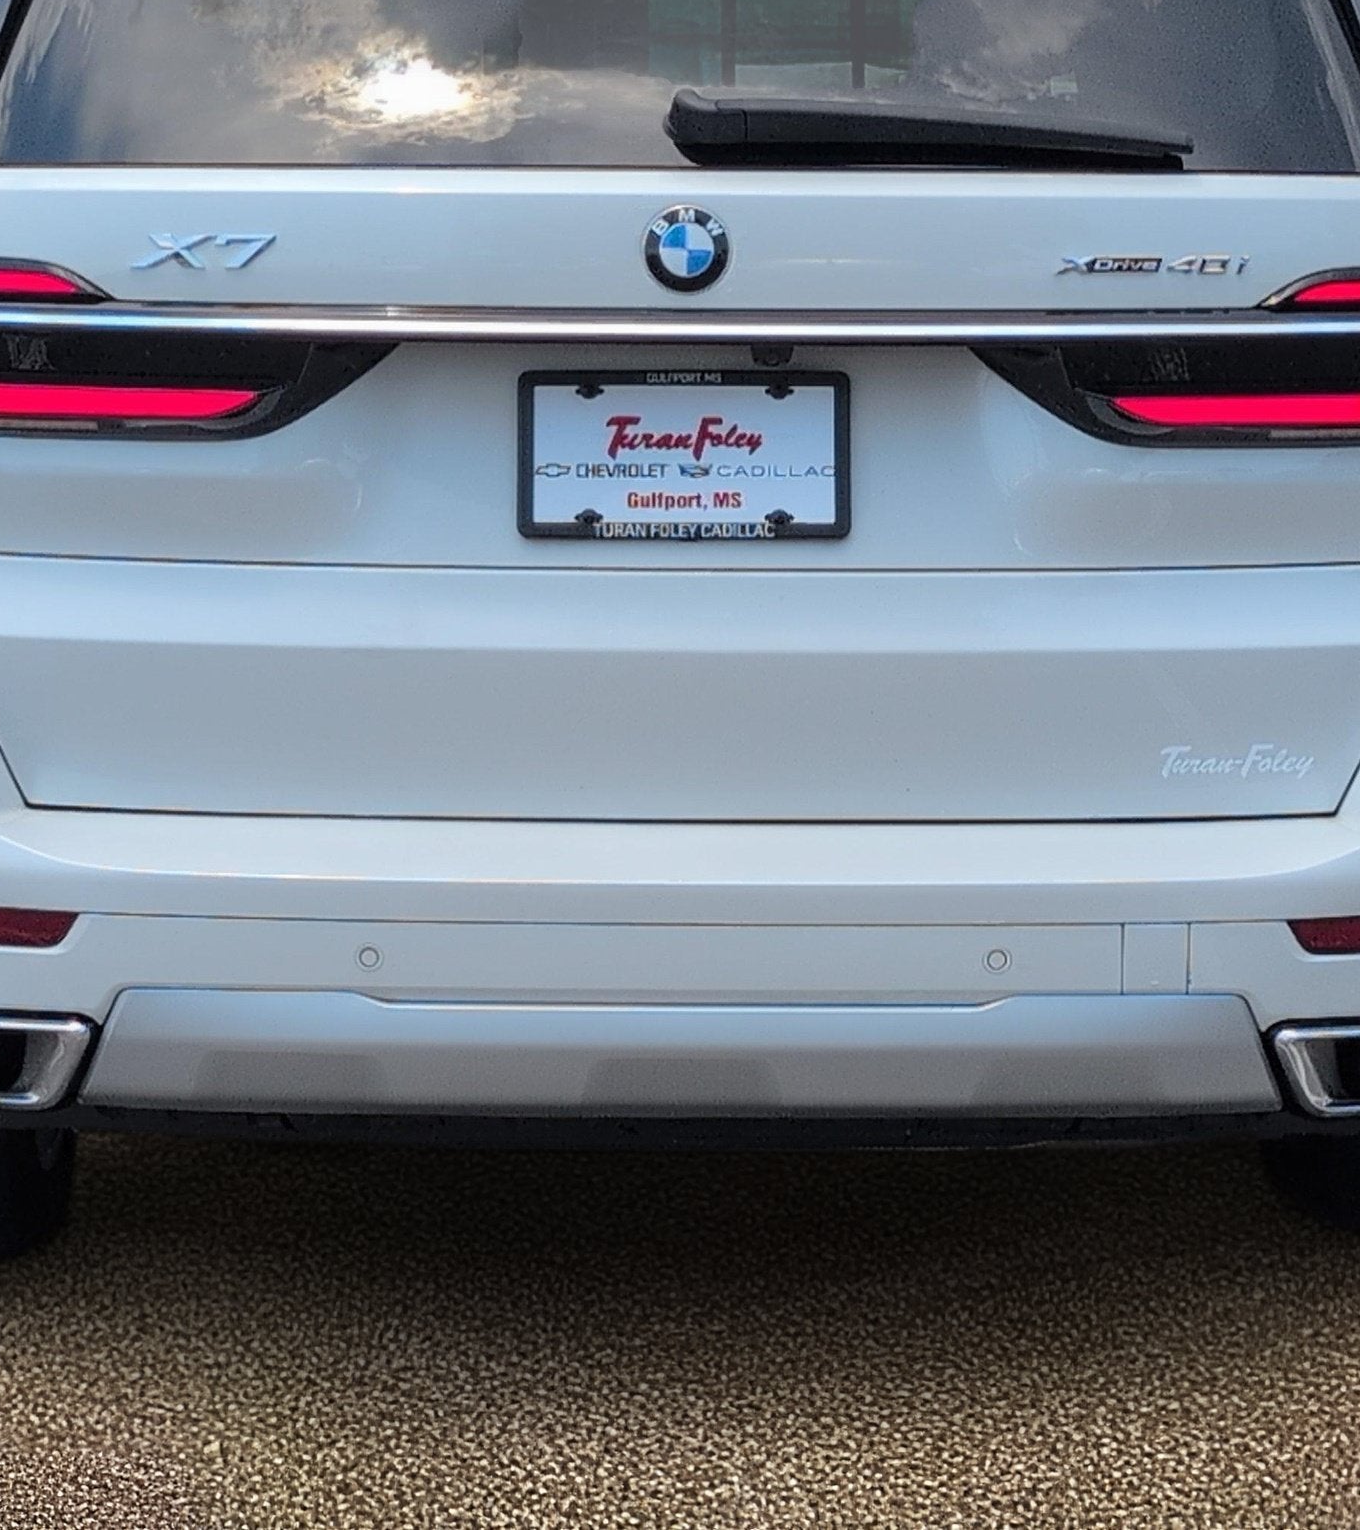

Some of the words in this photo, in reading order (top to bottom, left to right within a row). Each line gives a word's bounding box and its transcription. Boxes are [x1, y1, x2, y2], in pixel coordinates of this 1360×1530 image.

[651, 208, 725, 238] BMW
[130, 232, 278, 271] X7
[575, 463, 668, 478] CHEVROLET
[717, 464, 836, 478] CADILLAC
[627, 492, 709, 512] Gulfport,
[713, 493, 742, 509] MS
[593, 523, 647, 538] TURAN
[650, 523, 698, 538] FOLEY
[700, 522, 776, 538] CADILLAC
